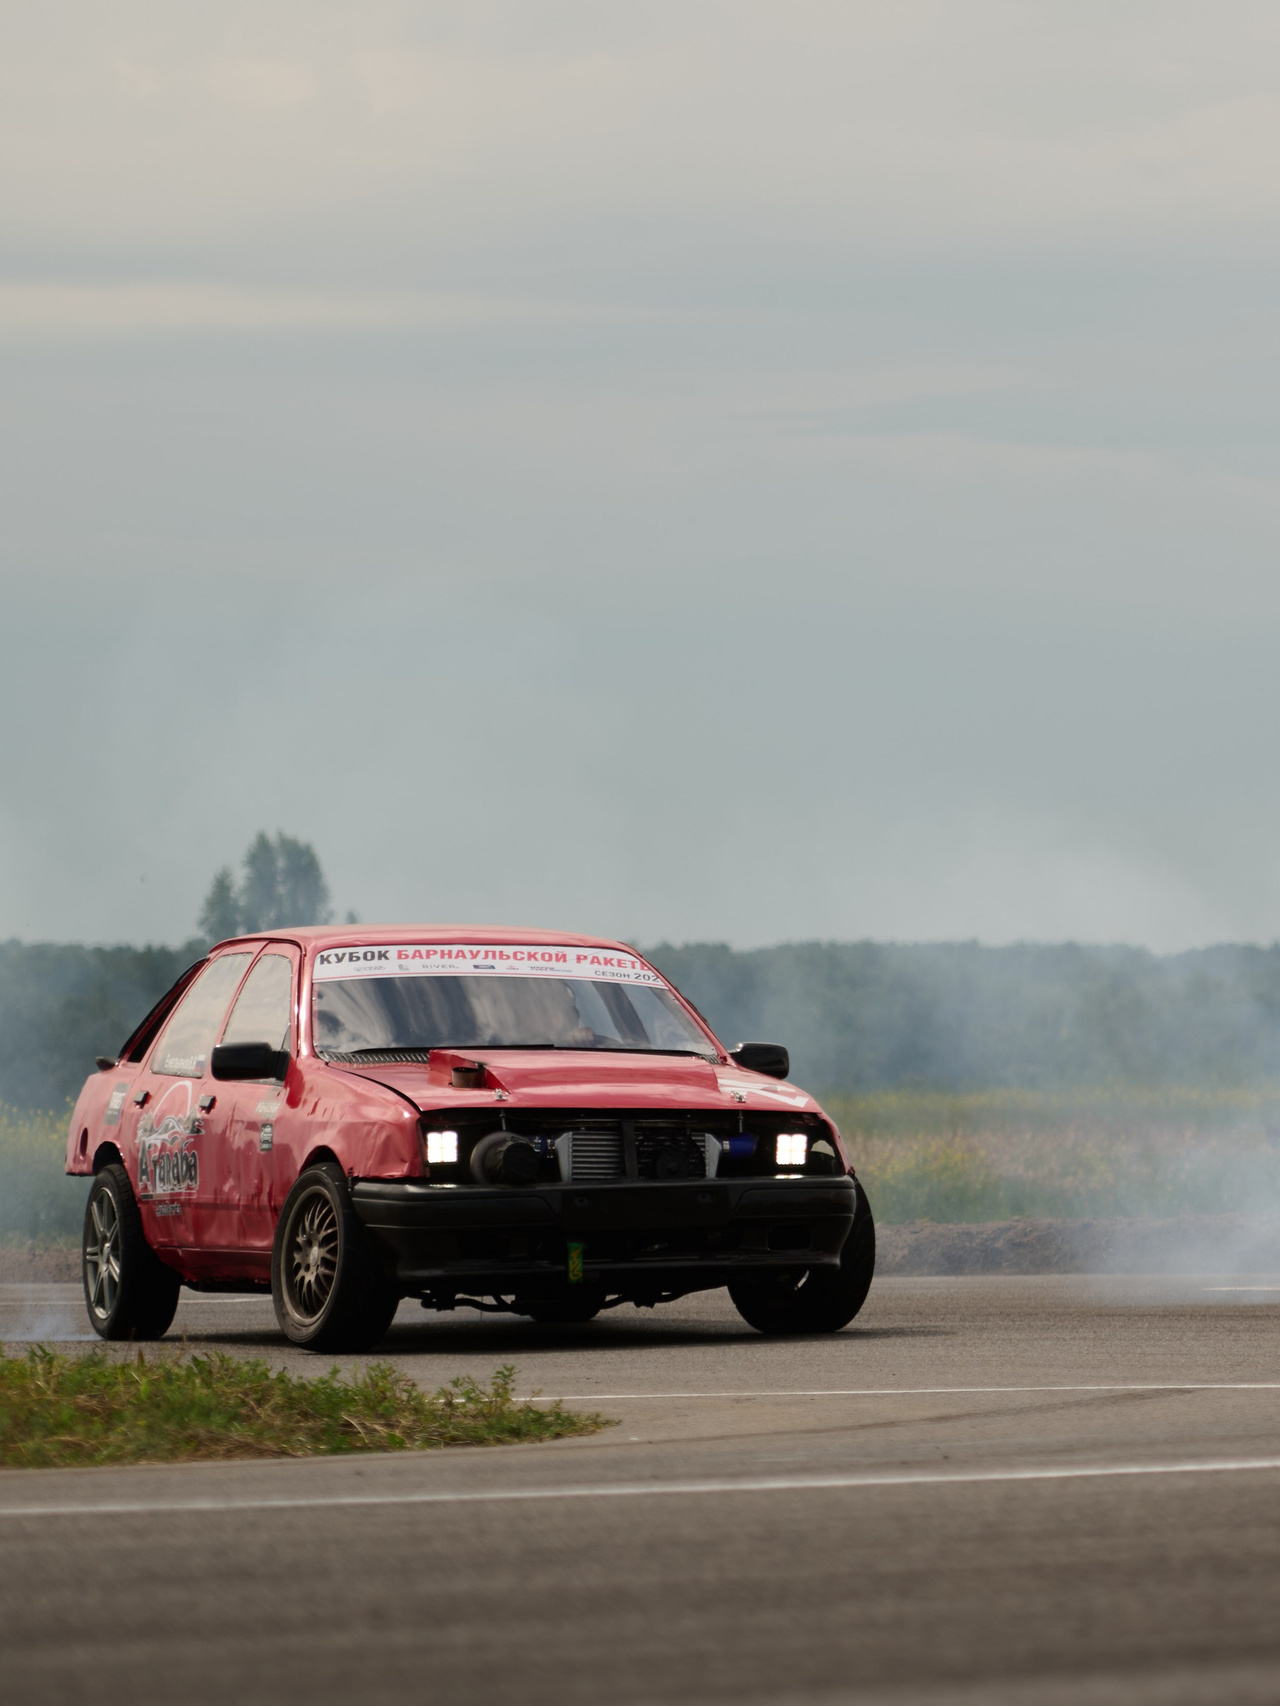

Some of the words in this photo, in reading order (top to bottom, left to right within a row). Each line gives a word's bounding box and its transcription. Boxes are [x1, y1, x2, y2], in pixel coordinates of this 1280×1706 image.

[320, 950, 390, 965] КУБОК
[397, 949, 567, 963] БАРНАУЛЬСКОЙ
[595, 970, 630, 979] СЕЗОН
[634, 972, 661, 983] 202
